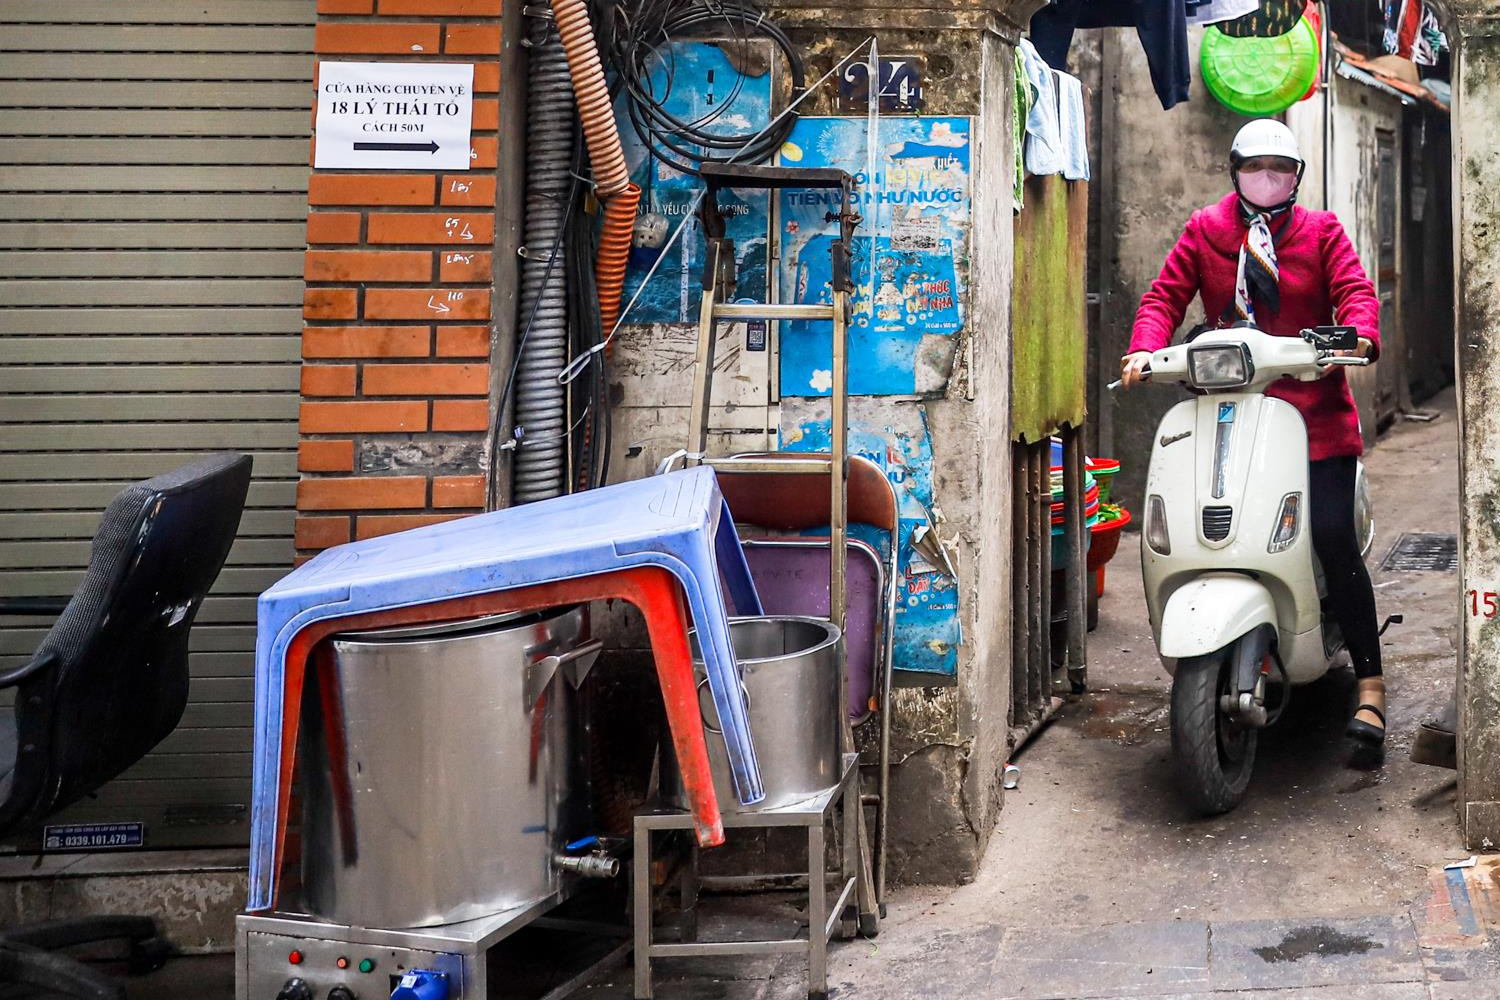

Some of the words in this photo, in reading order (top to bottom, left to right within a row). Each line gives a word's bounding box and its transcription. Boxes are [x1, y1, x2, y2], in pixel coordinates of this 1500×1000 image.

[355, 81, 391, 94] HÀNG
[331, 101, 348, 115] 18
[353, 97, 377, 115] LÝ
[383, 98, 428, 116] THÁI
[362, 121, 398, 133] CÁCH
[401, 123, 425, 132] 50M
[1470, 590, 1498, 618] 15
